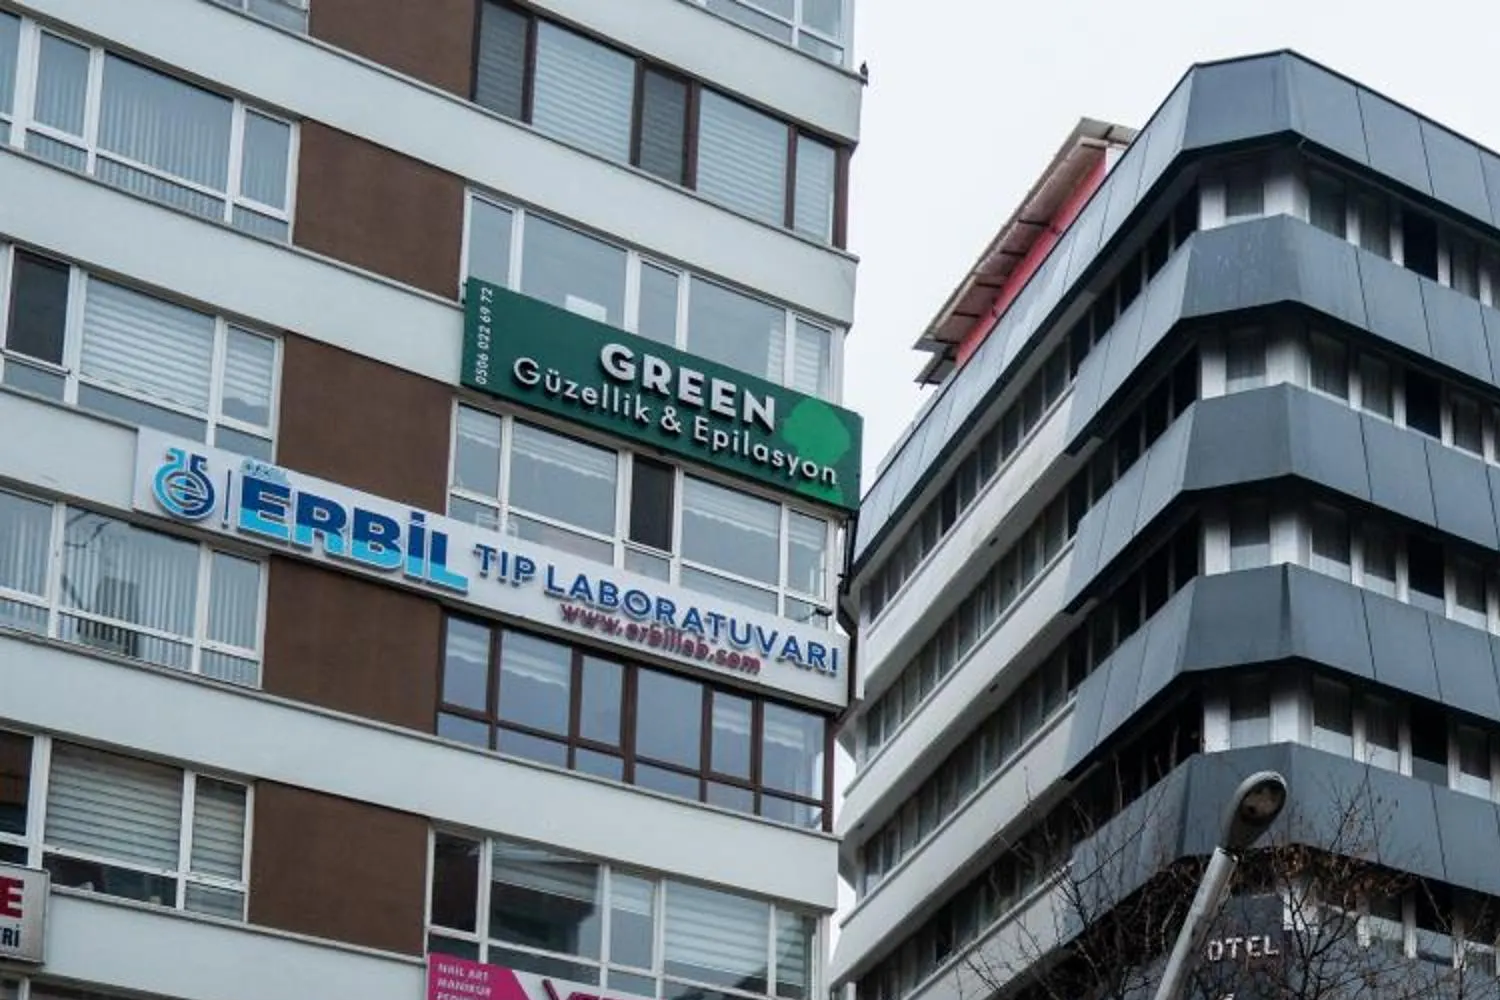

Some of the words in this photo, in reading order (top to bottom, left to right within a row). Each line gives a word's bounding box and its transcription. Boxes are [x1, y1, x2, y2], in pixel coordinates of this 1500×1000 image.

[481, 287, 493, 304] 72
[477, 325, 491, 350] 022
[600, 342, 776, 433] GREEN
[513, 356, 650, 424] Güzellik
[660, 405, 682, 433] &
[694, 417, 838, 486] Epilasyon
[236, 474, 469, 595] ERBİL
[475, 543, 537, 586] TIP
[544, 565, 839, 676] LABORATUVARI
[0, 923, 20, 948] Rİ
[1207, 935, 1279, 961] OTEL
